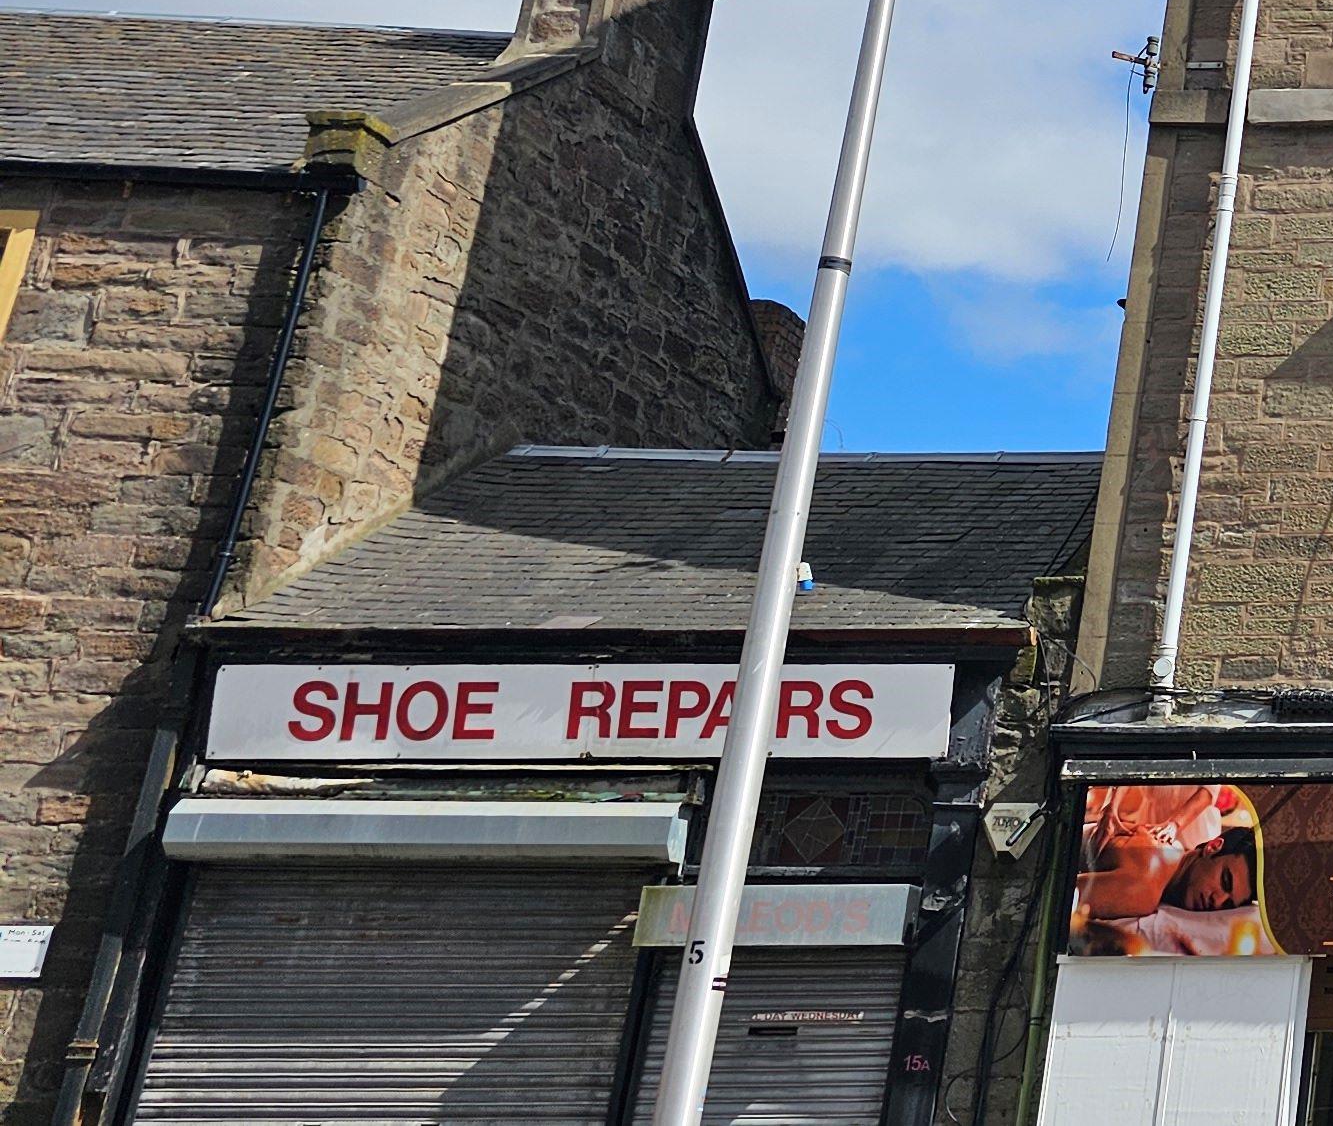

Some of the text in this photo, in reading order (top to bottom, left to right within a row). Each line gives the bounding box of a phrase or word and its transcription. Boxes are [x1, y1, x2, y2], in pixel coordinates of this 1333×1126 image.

[288, 680, 874, 741] SHOE REPARS
[688, 940, 705, 964] 5
[904, 1055, 930, 1072] 15A
